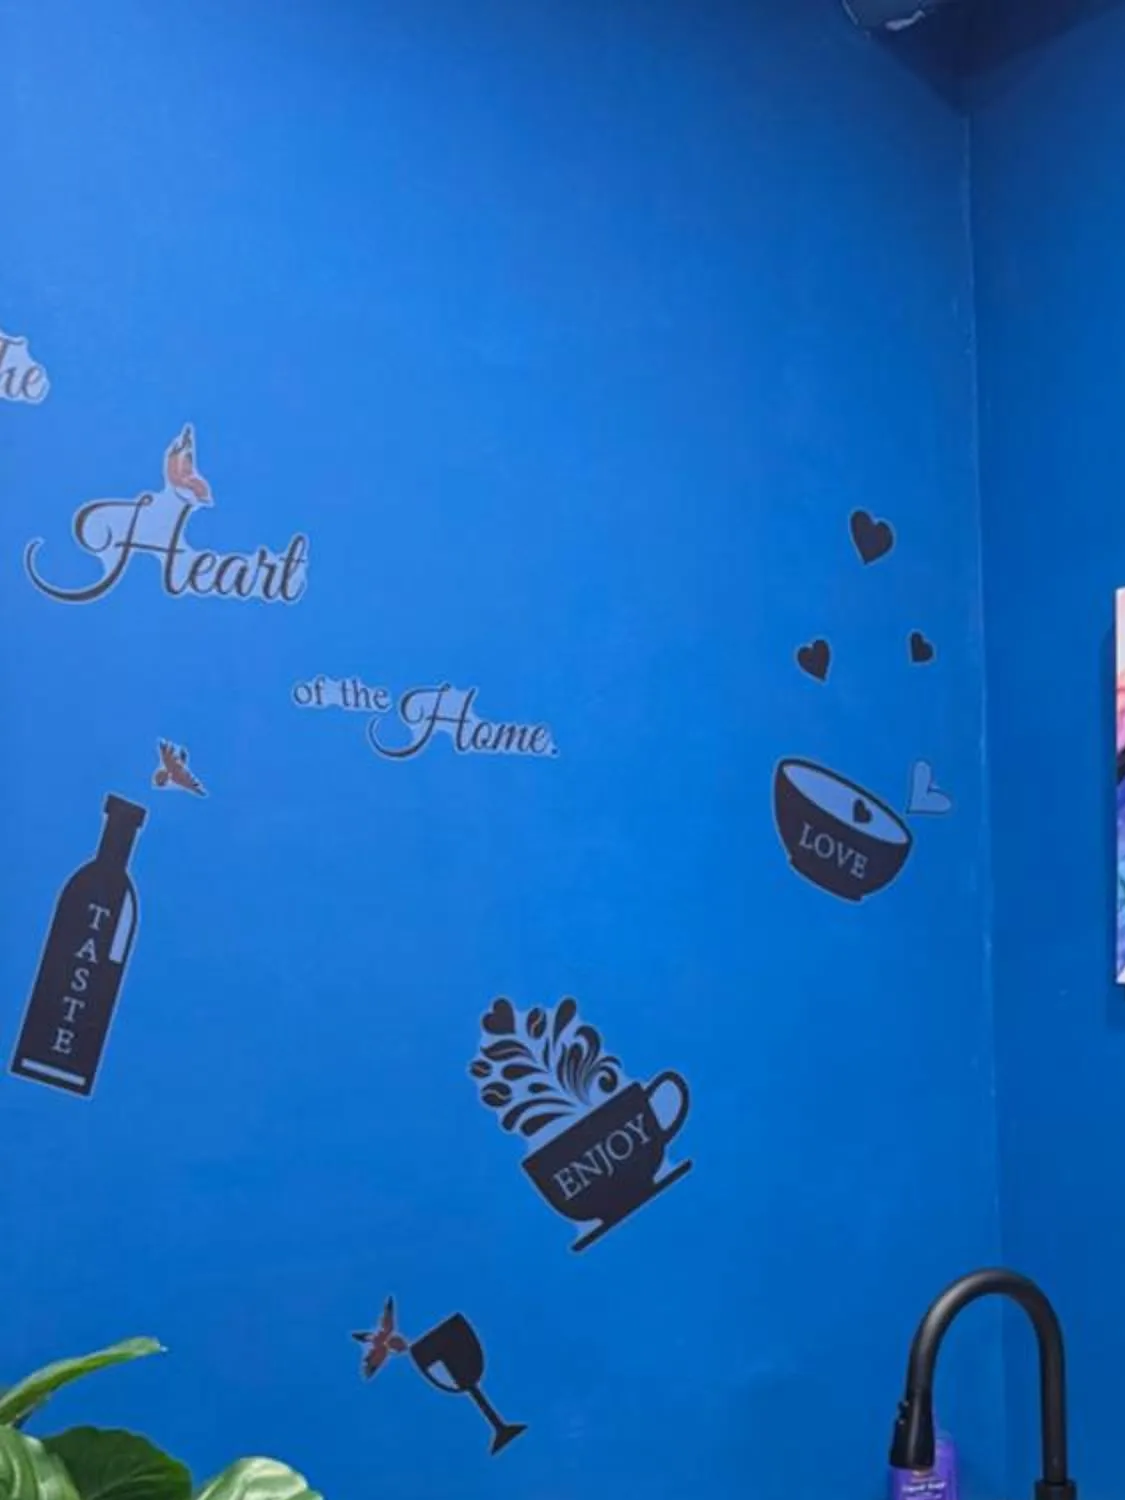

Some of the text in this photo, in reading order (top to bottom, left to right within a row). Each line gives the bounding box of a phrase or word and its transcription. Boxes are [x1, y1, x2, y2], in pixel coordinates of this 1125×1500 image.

[25, 494, 306, 602] Heart
[293, 676, 559, 757] of the Home.
[798, 821, 870, 880] LOVE
[51, 902, 111, 1055] TASTE
[552, 1112, 650, 1201] ENJOY
